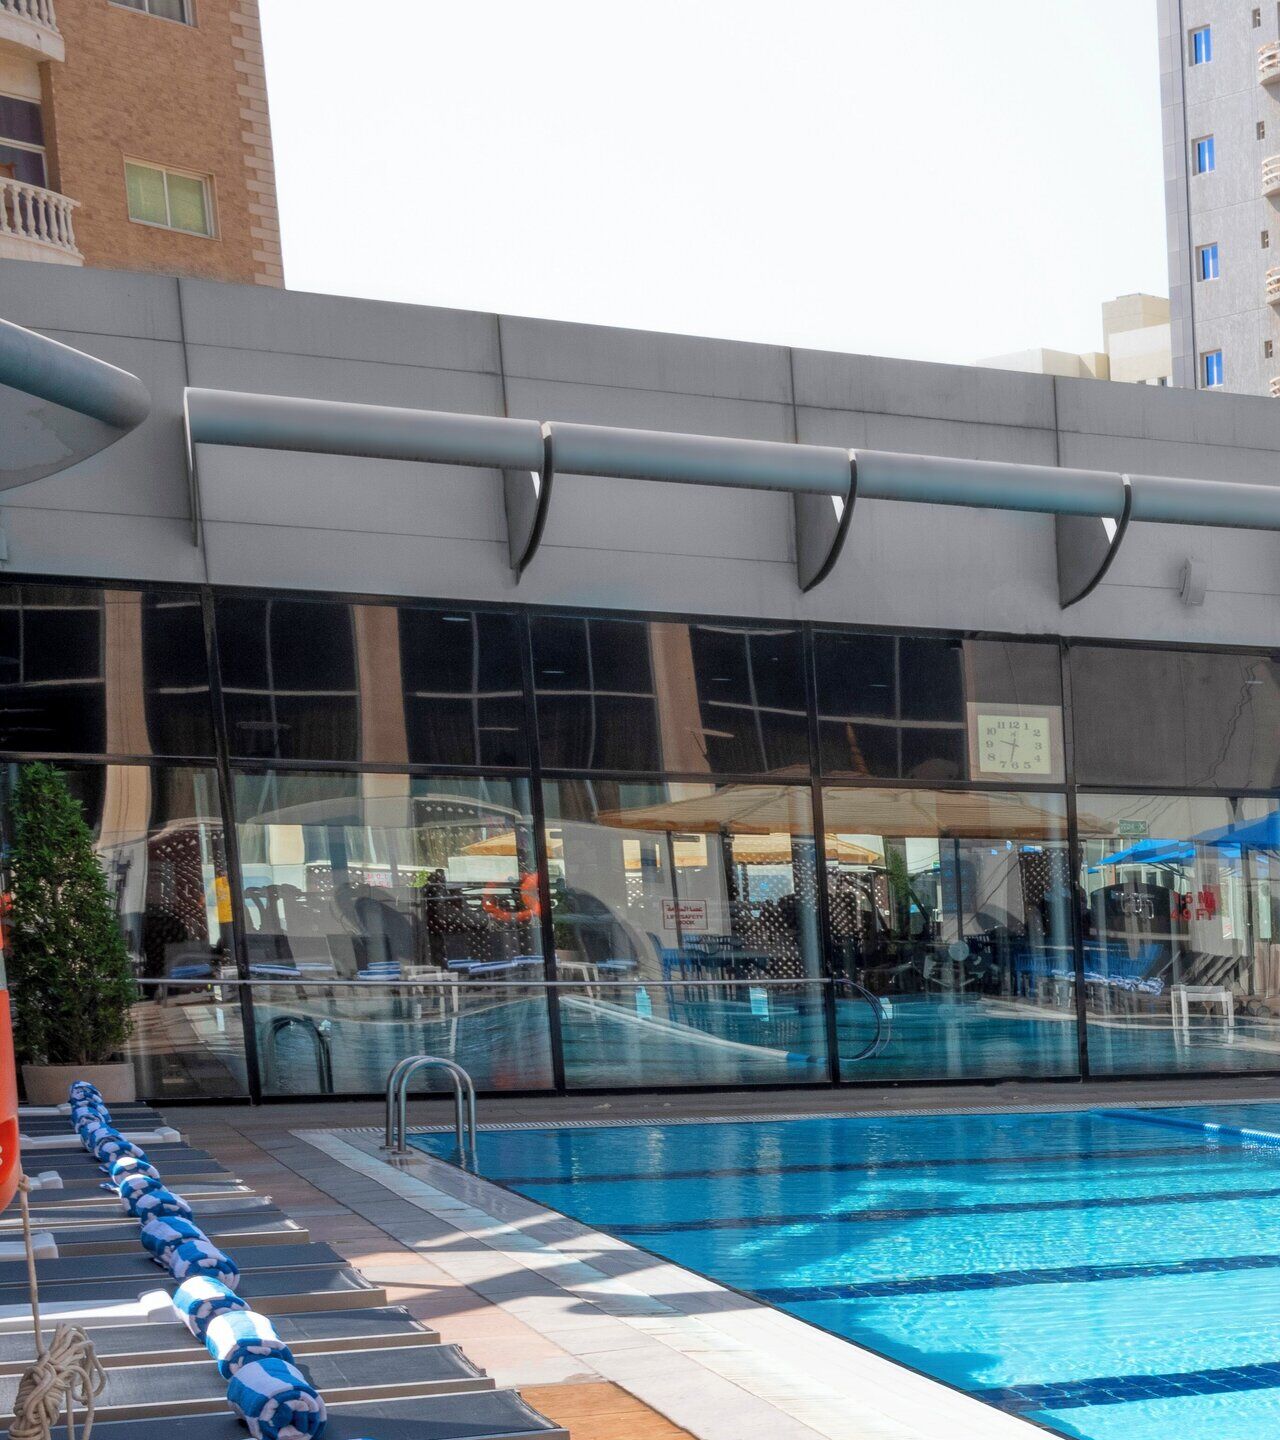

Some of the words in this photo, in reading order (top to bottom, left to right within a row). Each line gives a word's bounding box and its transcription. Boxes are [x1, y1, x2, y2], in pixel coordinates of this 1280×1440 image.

[998, 721, 1005, 729] 11
[1009, 721, 1020, 729] 12
[1024, 722, 1029, 730] 1
[987, 727, 997, 735] 10
[1033, 728, 1041, 737] 2
[986, 740, 994, 748] 9
[1034, 742, 1042, 750] 3
[987, 753, 996, 761] 8
[1034, 754, 1041, 762] 4
[1000, 760, 1007, 768] 7
[1011, 761, 1019, 769] 6
[1023, 761, 1031, 769] 5
